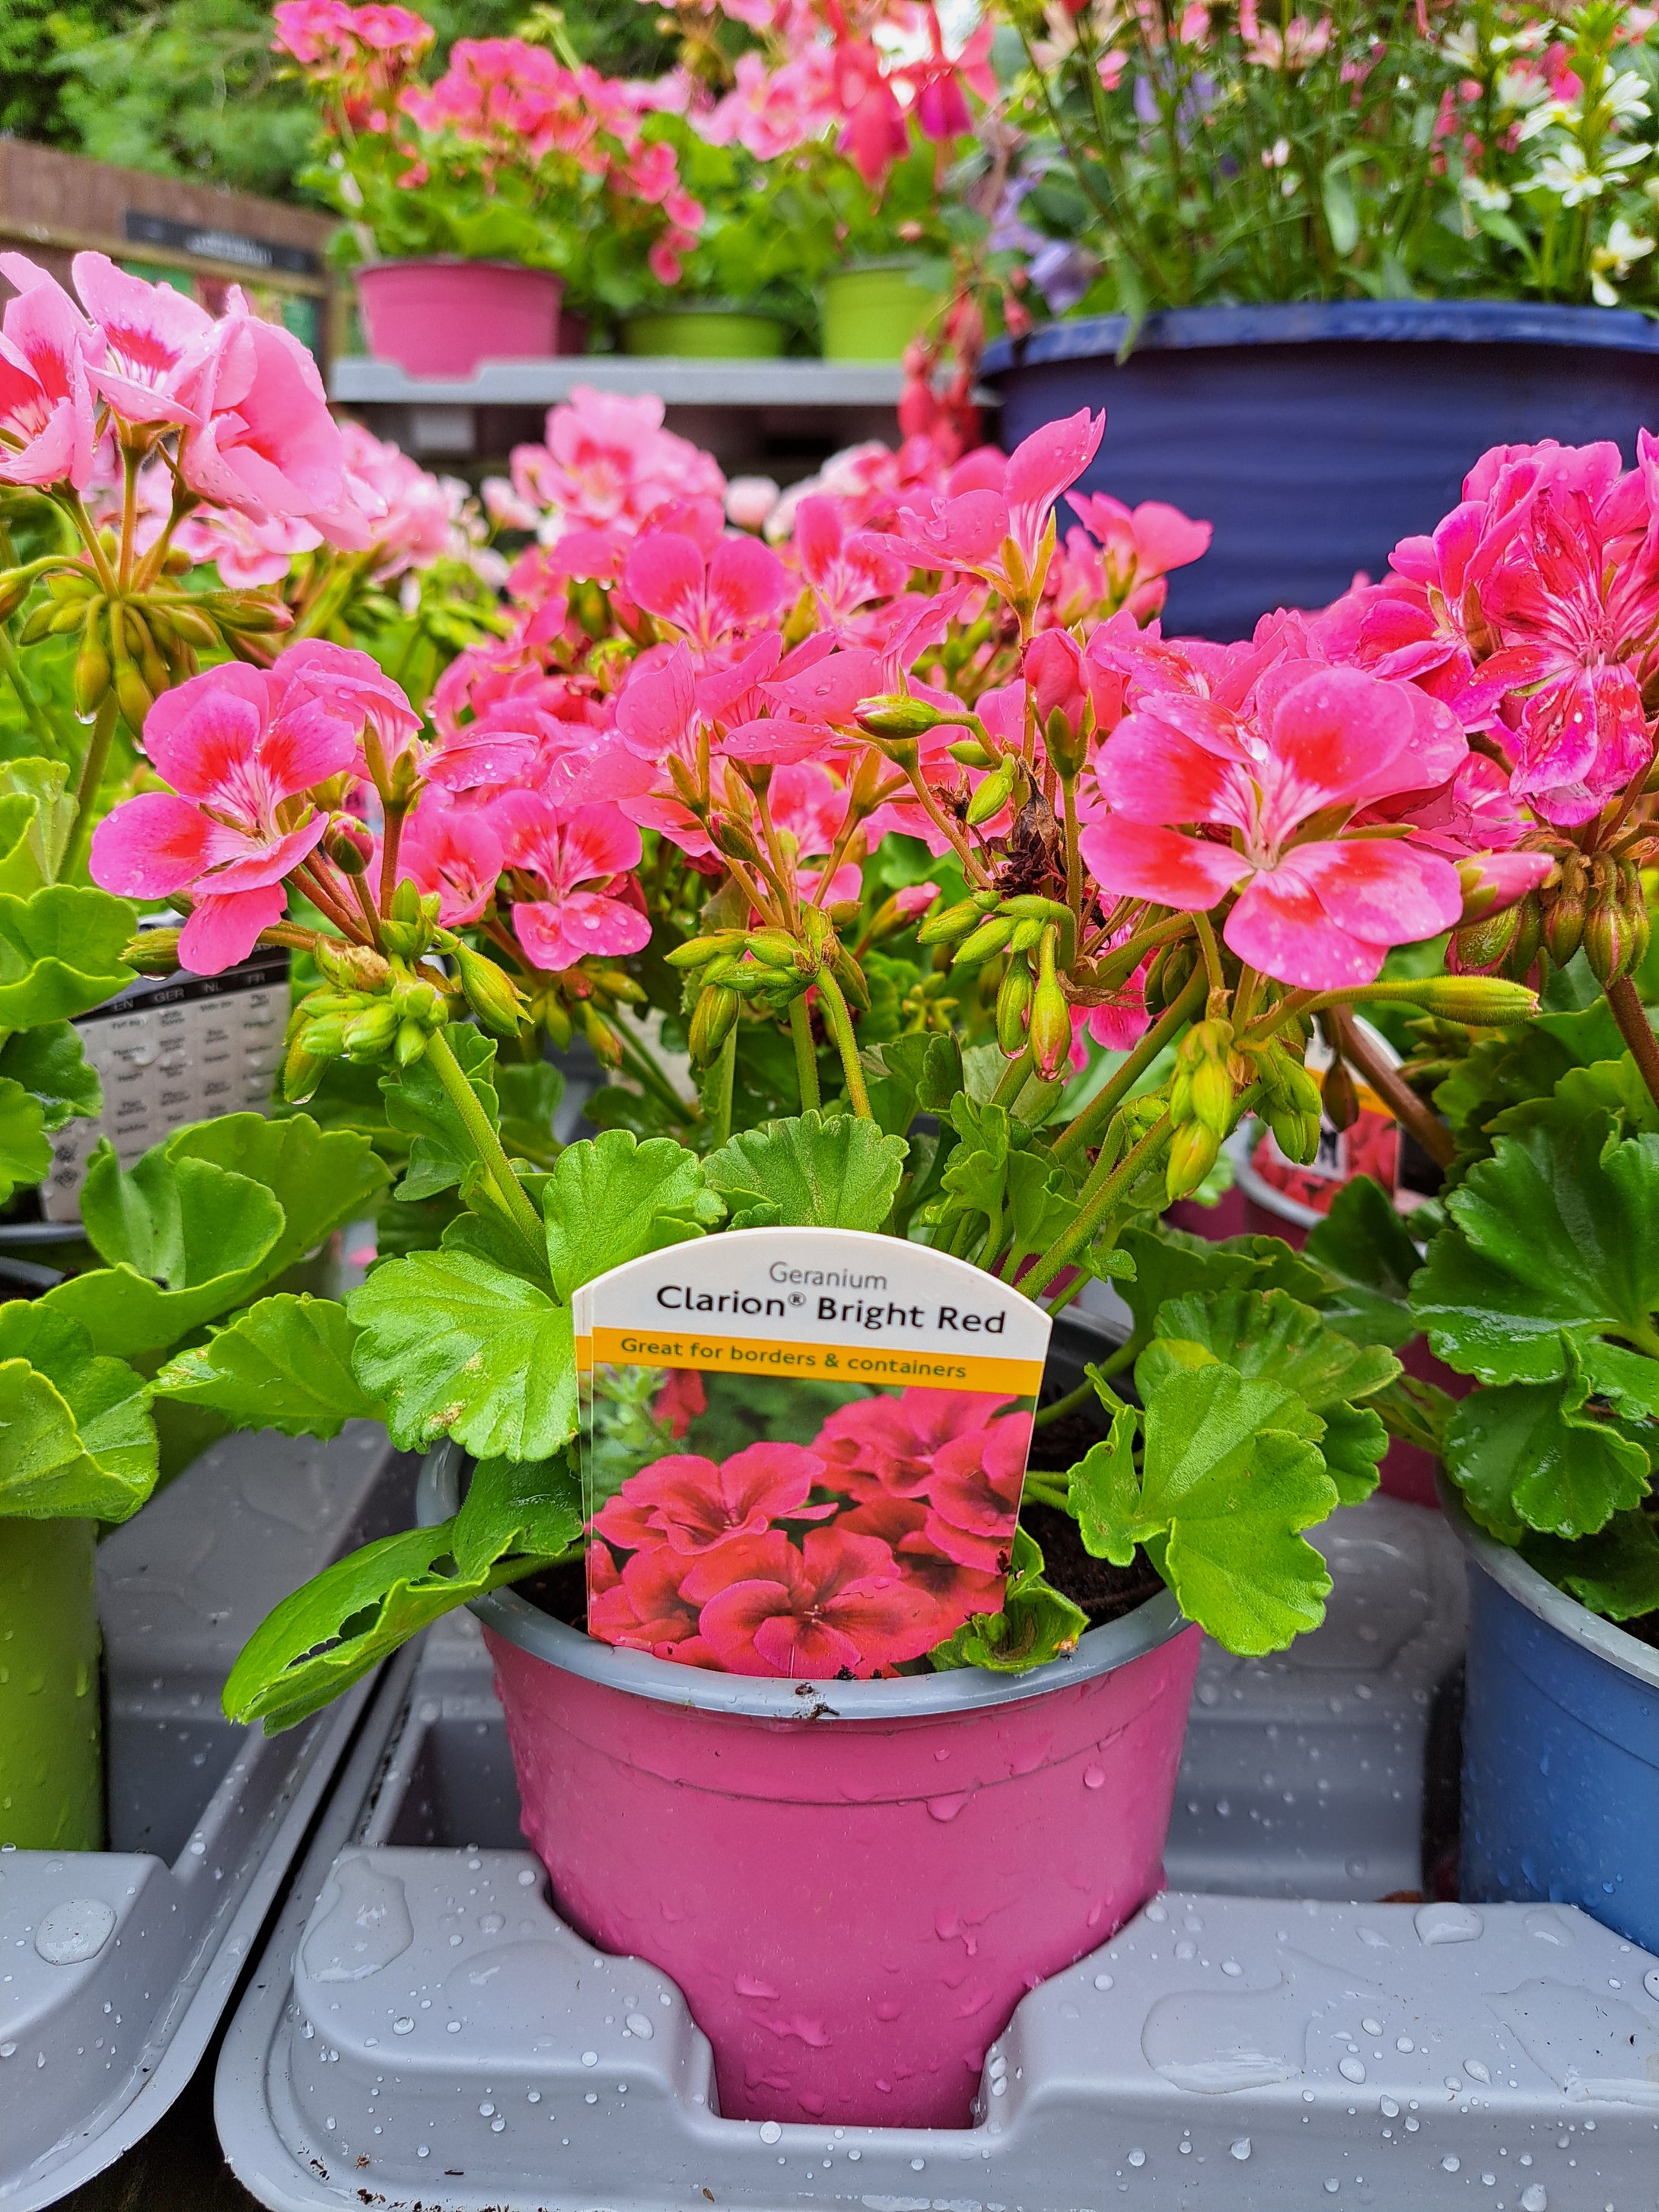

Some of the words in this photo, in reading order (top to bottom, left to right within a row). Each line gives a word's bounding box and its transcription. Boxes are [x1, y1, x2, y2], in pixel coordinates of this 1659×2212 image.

[154, 988, 185, 1002] GER
[769, 1261, 887, 1290] Geranium
[817, 1296, 925, 1330] Bright
[938, 1307, 1006, 1334] Red
[621, 1337, 683, 1357] Great
[689, 1343, 724, 1359] for
[731, 1345, 816, 1367] borders
[824, 1354, 840, 1369] &
[848, 1358, 966, 1379] containers
